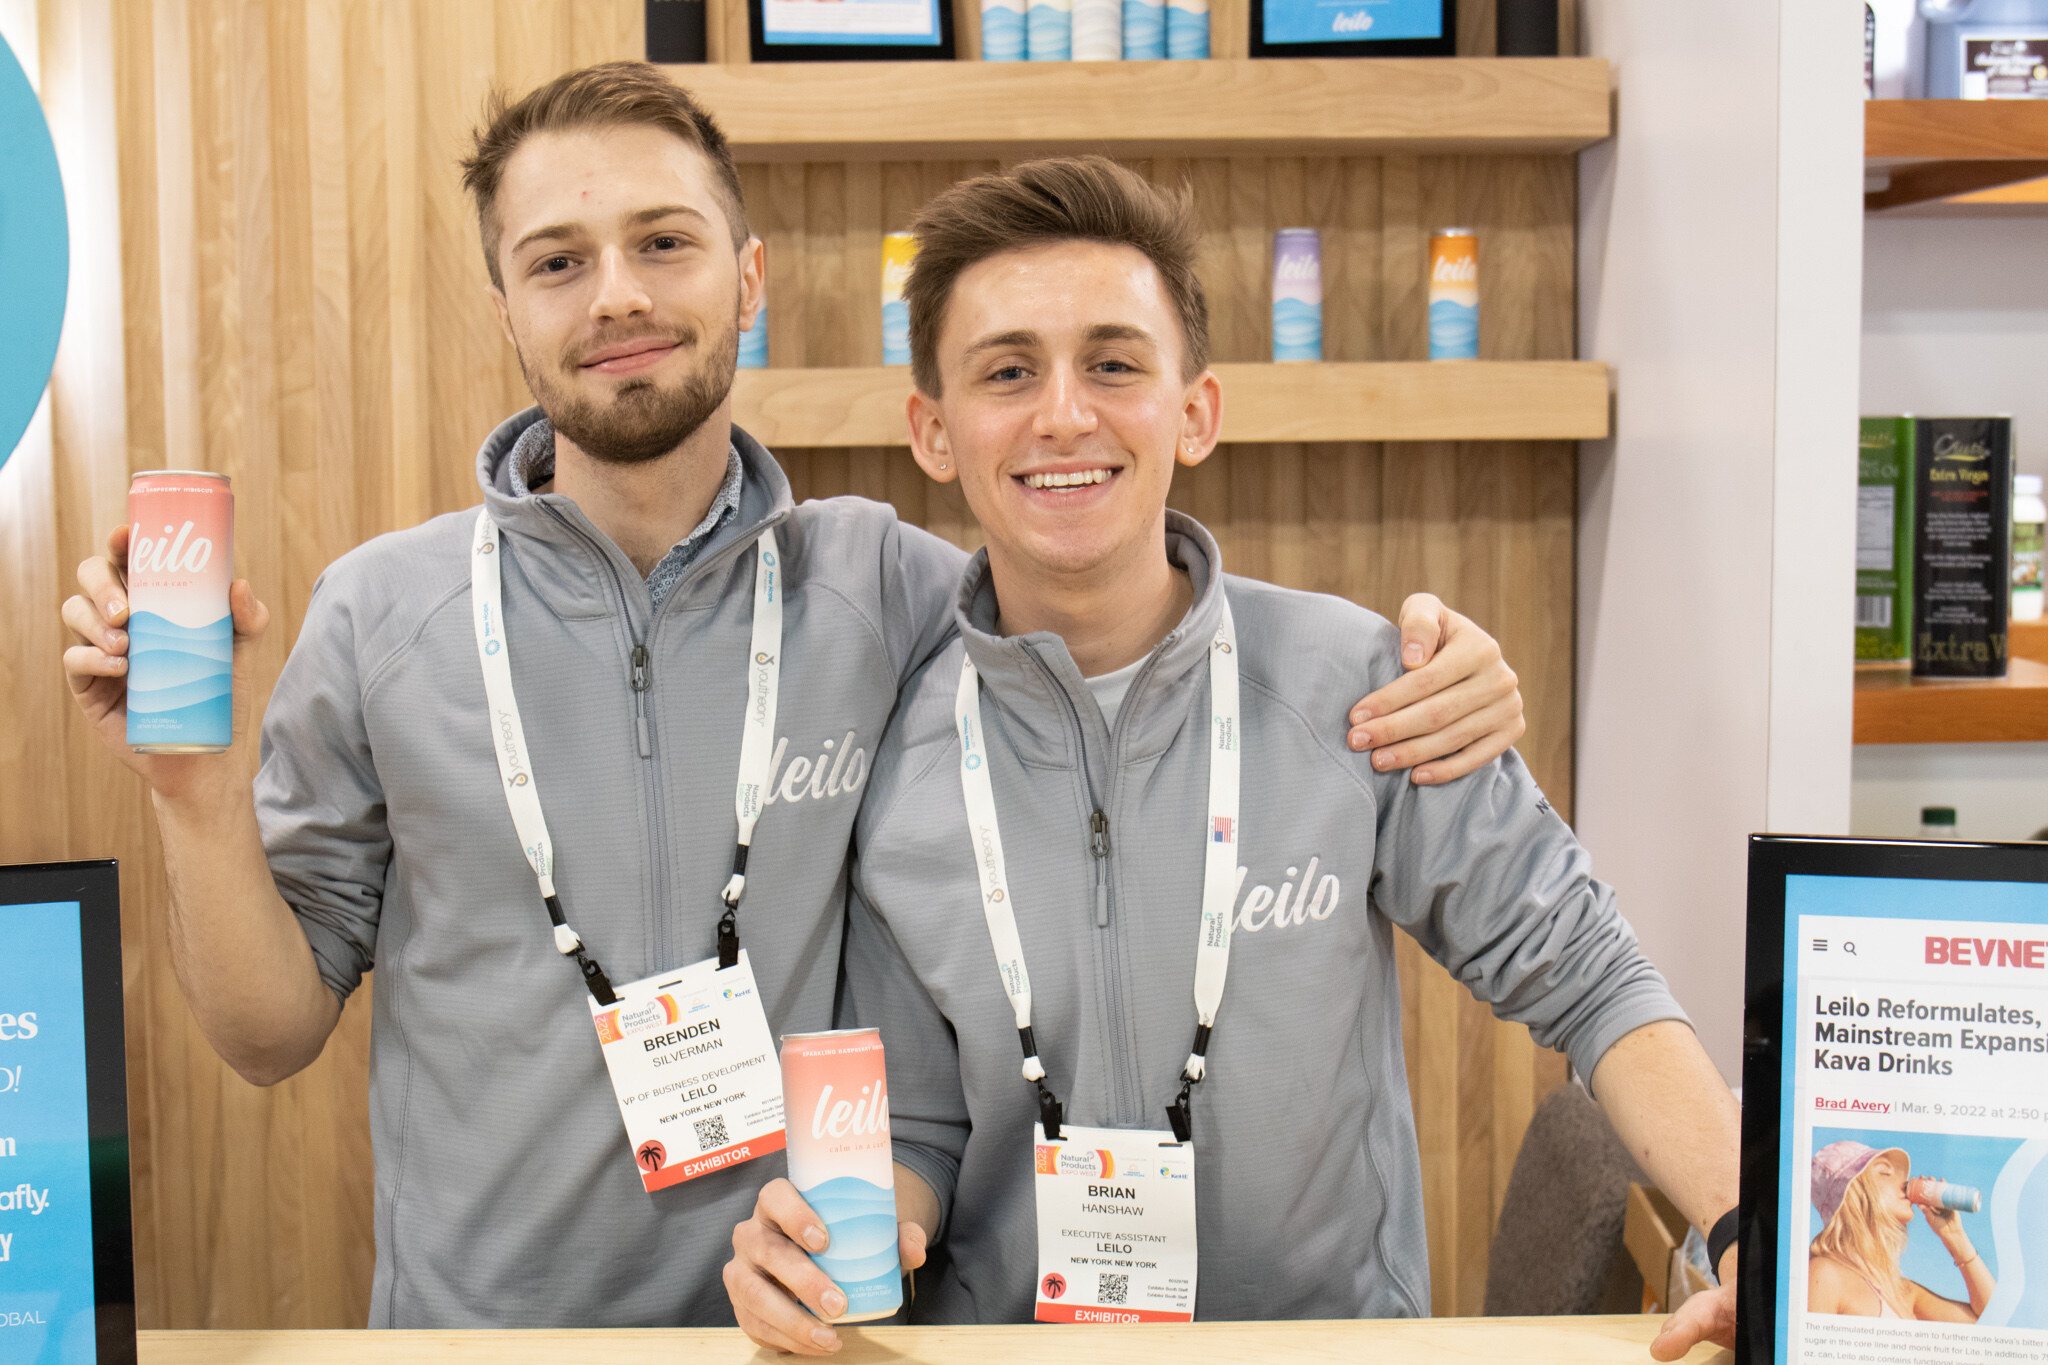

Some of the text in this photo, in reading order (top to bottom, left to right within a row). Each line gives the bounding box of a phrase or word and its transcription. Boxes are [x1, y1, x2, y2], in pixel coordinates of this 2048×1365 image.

[1919, 632, 1989, 661] Extra
[763, 730, 866, 806] leilo
[743, 783, 752, 818] Products
[751, 784, 759, 813] Natural
[538, 842, 547, 877] Products
[1206, 918, 1215, 947] Natural
[1214, 912, 1223, 948] Products
[1007, 967, 1016, 996] Natural
[1012, 959, 1021, 994] Products
[621, 1007, 652, 1022] Natural
[624, 1013, 661, 1030] Products
[1815, 995, 2042, 1029] Leilo Reformulates,
[596, 1015, 611, 1042] 2022
[643, 1018, 721, 1052] BRENDEN
[1815, 1021, 1953, 1049] Mainstream
[652, 1038, 723, 1068] SILVERMAN
[1814, 1048, 1954, 1076] Kava Drinks
[622, 1054, 767, 1106] VP OF BUSINESS DEVELOPMENT
[681, 1083, 718, 1103] LEILO
[659, 1113, 679, 1125] NEW
[679, 1105, 703, 1119] YORK
[704, 1099, 723, 1111] NEW
[723, 1091, 746, 1106] YORK
[1815, 1097, 1847, 1109] Brad
[1851, 1099, 1891, 1114] Avery
[1901, 1102, 1930, 1114] Mar.
[1934, 1103, 1947, 1116] 9,
[1950, 1104, 1987, 1117] 2022
[1991, 1107, 2004, 1118] at
[2008, 1107, 2040, 1120] 2:50
[683, 1145, 751, 1177] EXHIBITOR
[1037, 1146, 1048, 1172] 2022
[1061, 1154, 1090, 1163] Natural
[1061, 1161, 1096, 1170] Products
[1088, 1185, 1136, 1199] BRIAN
[1082, 1203, 1144, 1216] HANSHAW
[1061, 1229, 1167, 1243] EXECUTIVE ASSISTANT
[1096, 1243, 1132, 1254] LEILO
[1070, 1256, 1157, 1269] NEW YORK NEW YORK
[1074, 1309, 1140, 1323] EXHIBITOR
[1805, 1322, 1820, 1330] The
[1822, 1324, 1874, 1335] reformulated
[1876, 1328, 1913, 1338] products
[1914, 1330, 1929, 1339] aim
[1941, 1332, 1969, 1341] further
[1970, 1335, 1992, 1343] mute
[1994, 1336, 2020, 1345] kava's
[2022, 1338, 2044, 1347] bitter
[1804, 1337, 1827, 1346] sugar
[1854, 1340, 1872, 1348] core
[1874, 1341, 1889, 1349] line
[1890, 1342, 1907, 1350] and
[1908, 1343, 1931, 1352] monk
[1934, 1345, 1950, 1353] fruit
[1951, 1346, 1963, 1354] for
[1994, 1350, 2028, 1359] addition
[2030, 1353, 2039, 1361] to
[1818, 1351, 1835, 1360] can,
[1837, 1352, 1856, 1360] Leilo
[1858, 1353, 1875, 1361] also
[1877, 1355, 1911, 1365] contains
